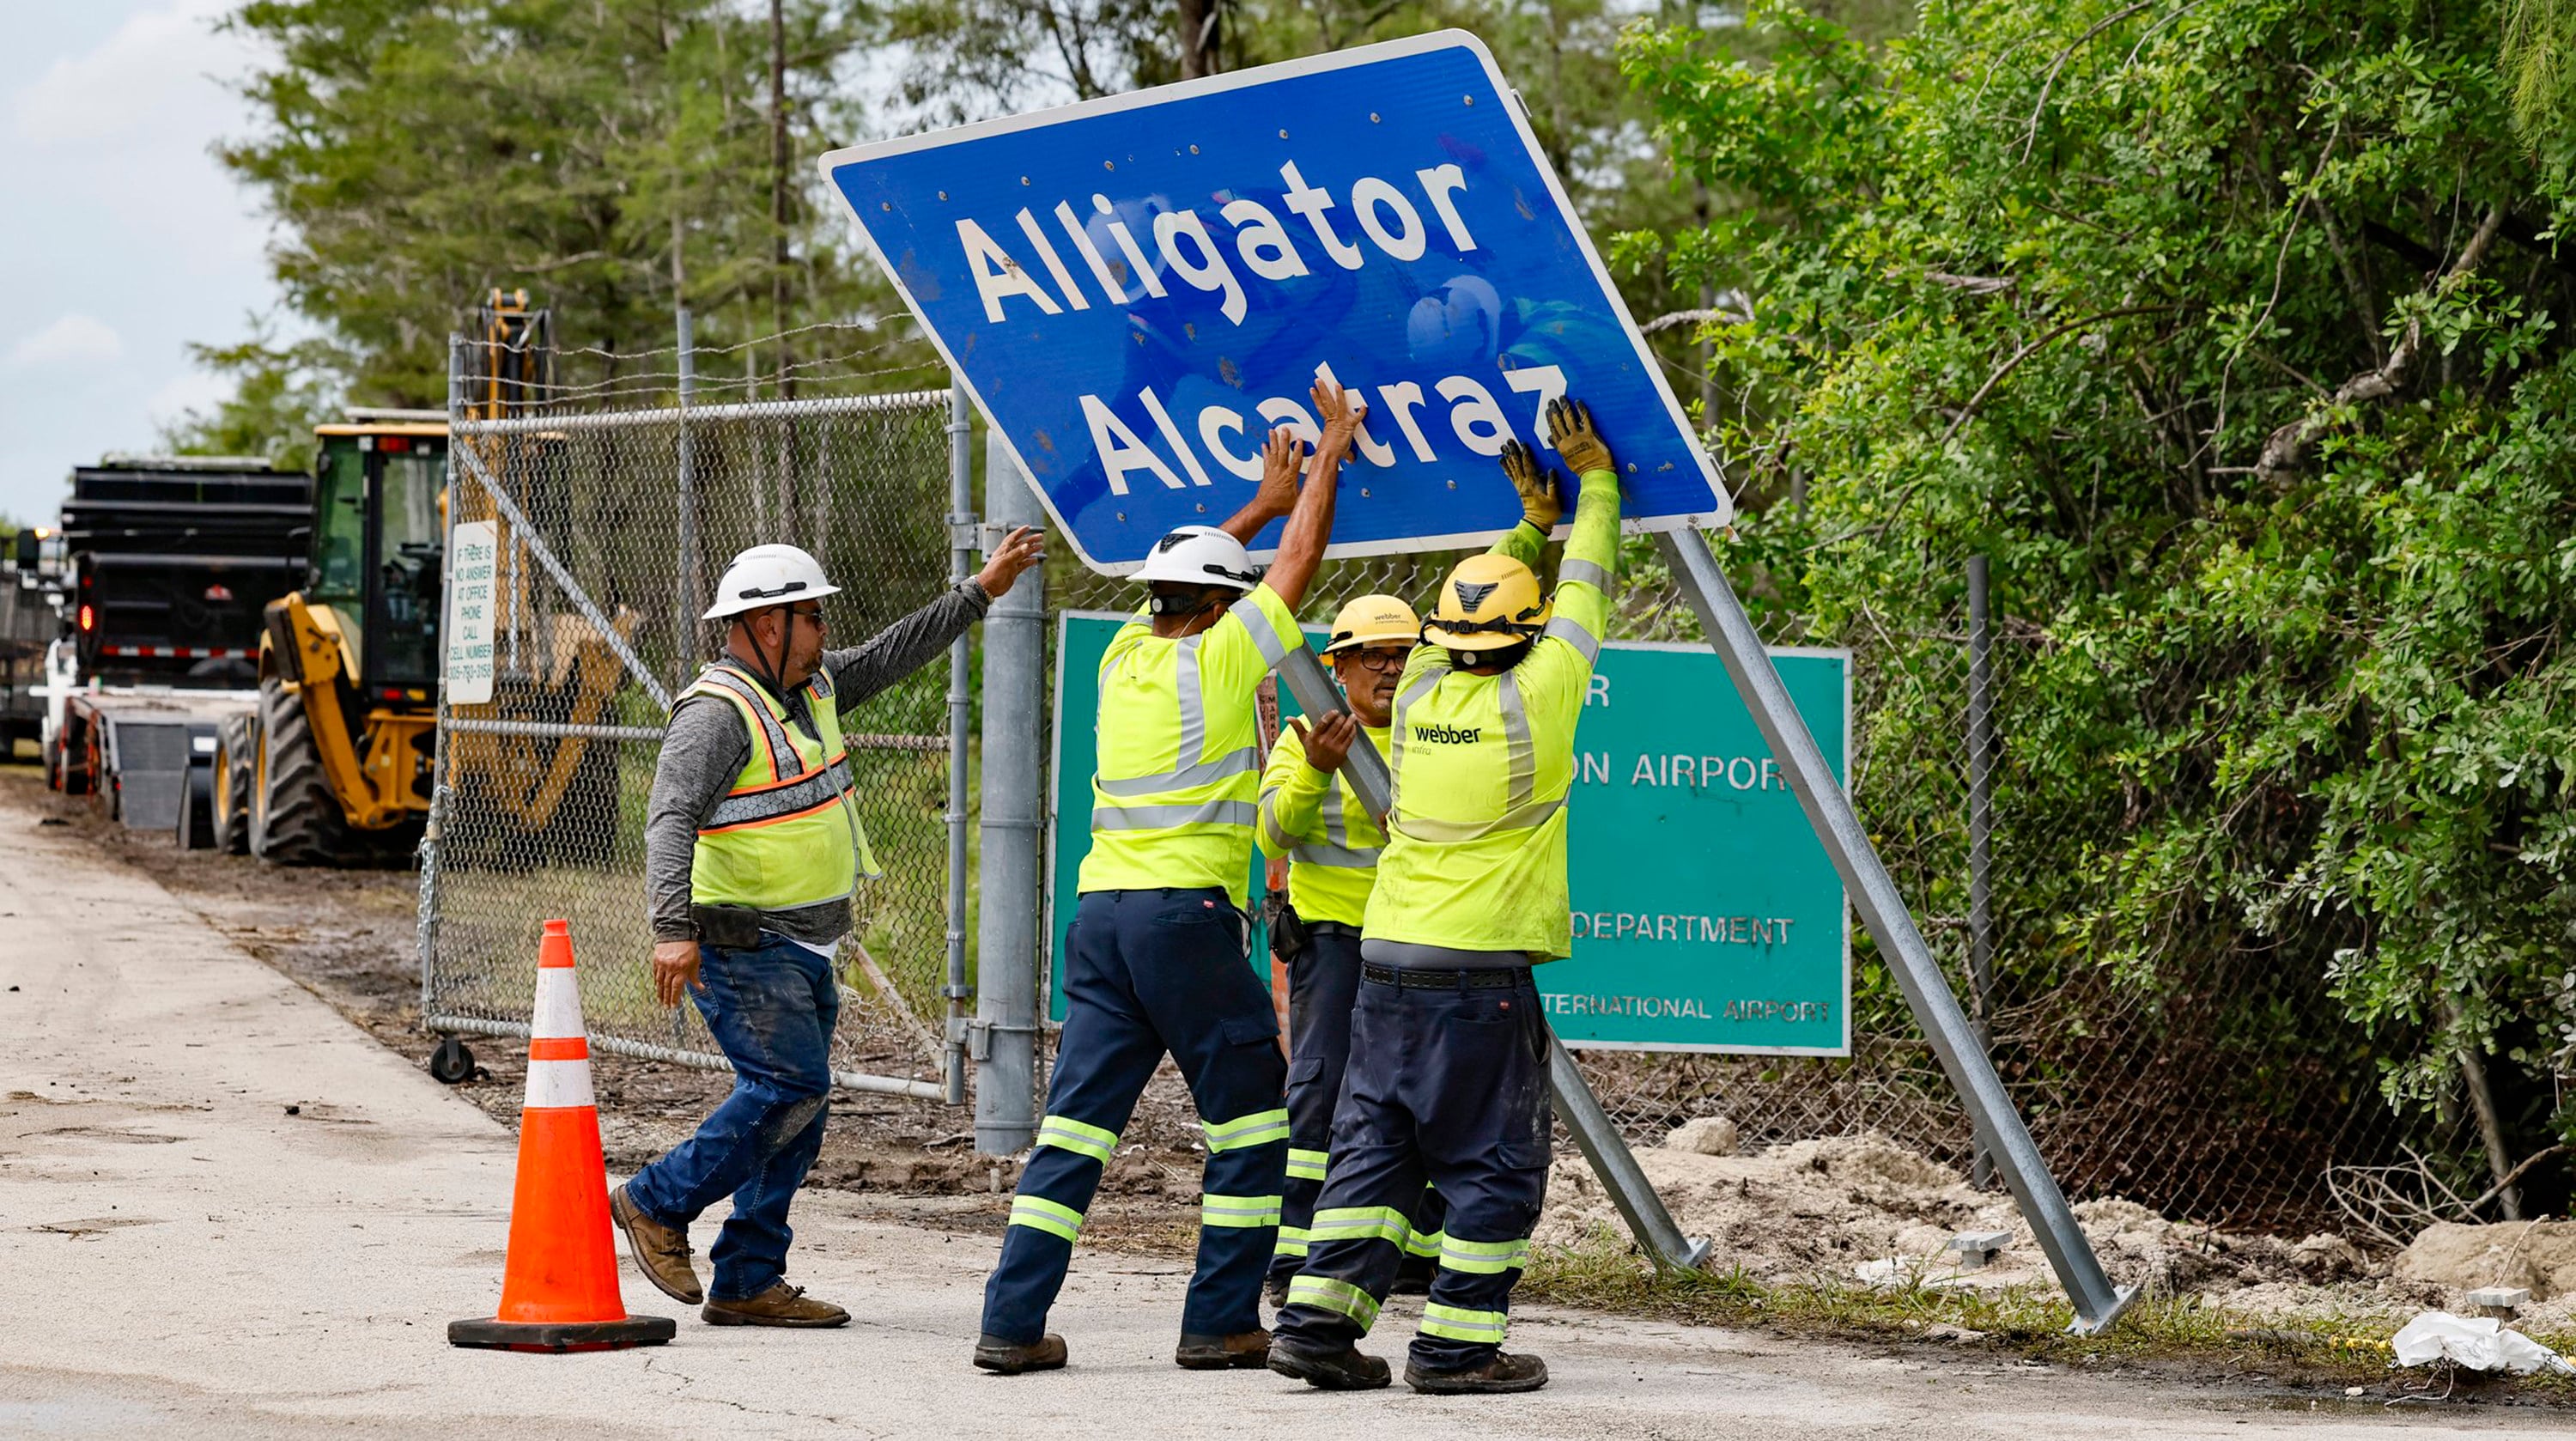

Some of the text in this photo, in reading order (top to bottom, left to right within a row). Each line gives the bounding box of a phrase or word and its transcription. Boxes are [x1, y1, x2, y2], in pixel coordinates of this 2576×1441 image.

[956, 159, 1477, 325] Alligator
[1078, 361, 1568, 496] Alcatraz
[457, 544, 491, 562] IF THERE IS
[455, 565, 491, 582] NO ANSWER
[458, 585, 488, 601] AT OFFICE
[461, 605, 482, 621] PHONE
[463, 625, 477, 641] CALL
[449, 644, 492, 660] CELL NUMBER
[1415, 724, 1481, 745] webber
[1631, 753, 1785, 791] AIRPOR
[1571, 912, 1795, 945] DEPARTMENT
[1540, 993, 1830, 1022] TERNATIONAL AIRPORT
